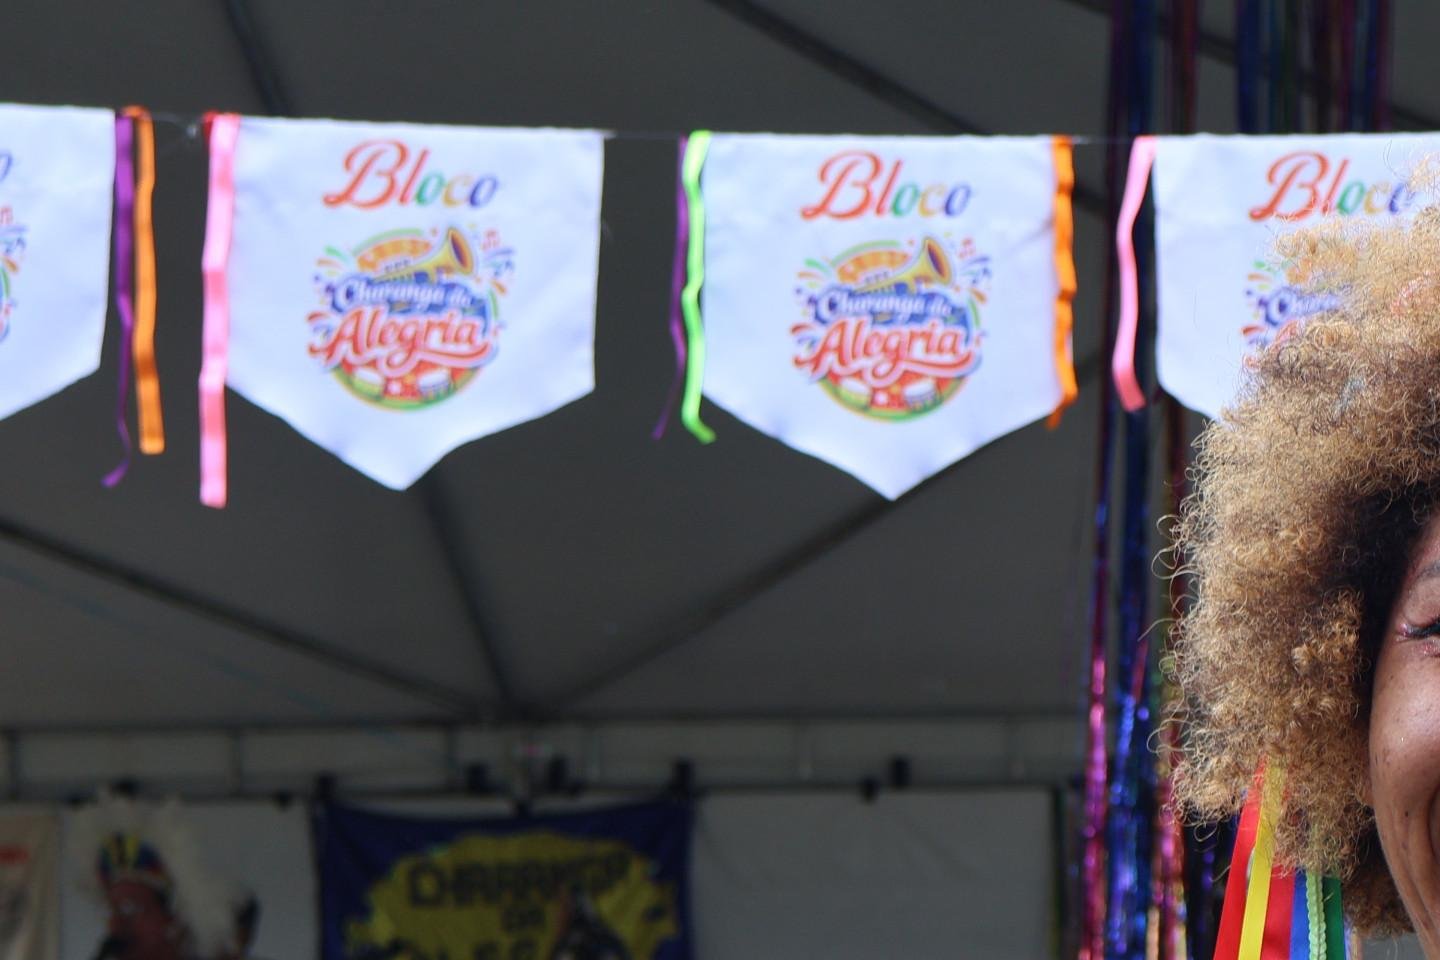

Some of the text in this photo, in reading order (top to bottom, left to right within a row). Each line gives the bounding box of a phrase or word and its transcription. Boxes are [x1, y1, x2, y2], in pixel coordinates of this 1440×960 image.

[323, 138, 500, 210] Bloco
[801, 149, 973, 220] Bloco
[308, 306, 490, 372] Alegria
[792, 320, 973, 382] Alegria
